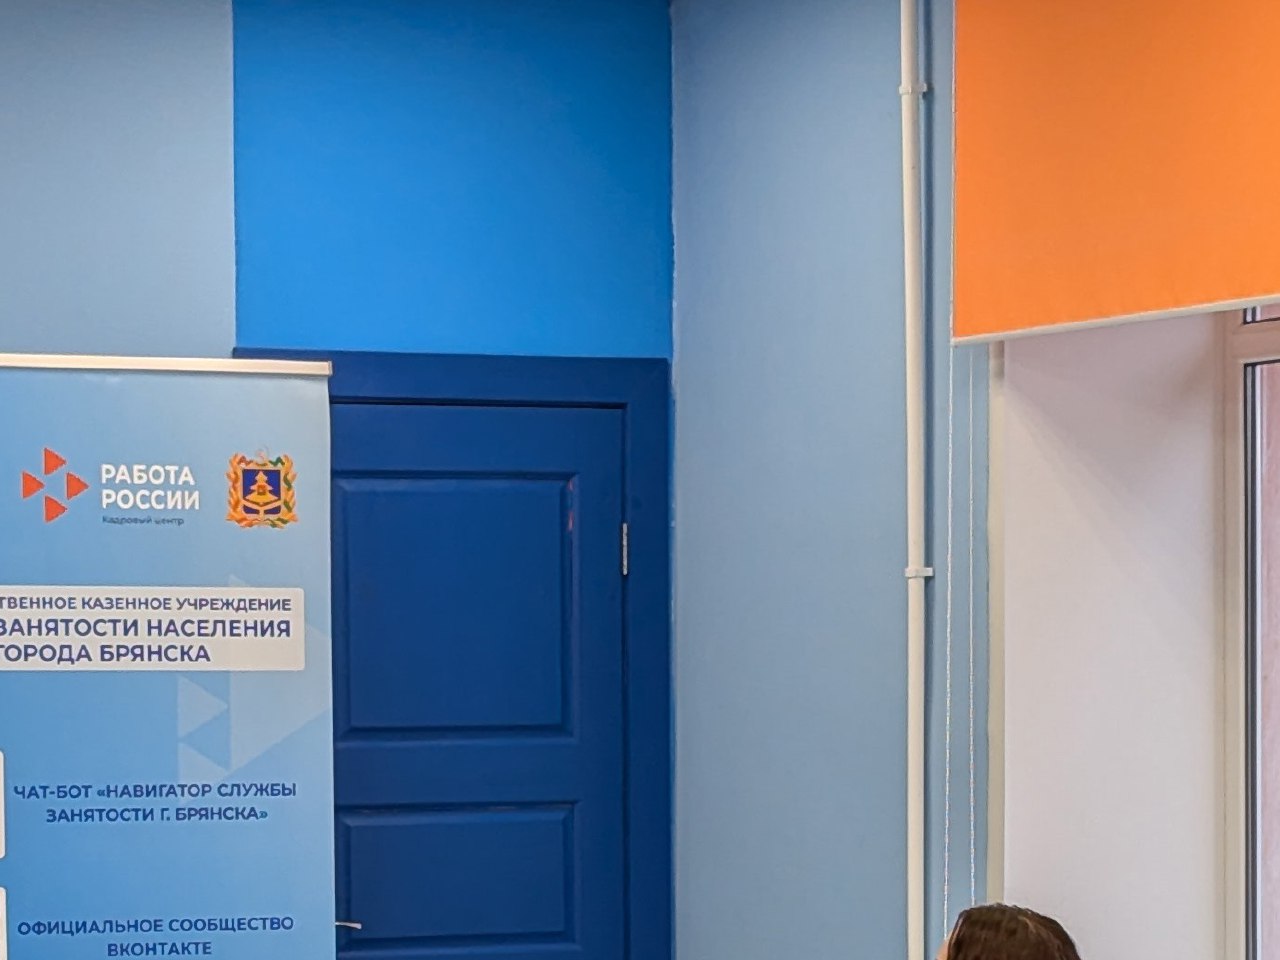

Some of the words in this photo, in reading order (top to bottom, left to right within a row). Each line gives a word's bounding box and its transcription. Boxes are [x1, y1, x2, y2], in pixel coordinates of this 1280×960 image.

[101, 463, 196, 486] РАБОТА
[101, 489, 200, 510] РОССИИ
[102, 515, 152, 525] Кадровый
[154, 518, 185, 526] центр
[81, 596, 172, 611] КАЗЕННОЕ
[176, 598, 292, 613] УЧРЕЖДЕНИЕ
[146, 619, 291, 638] НАСЕЛЕНИЯ
[100, 644, 211, 662] БРЯНСКА
[13, 784, 93, 799] ЧАТ-БОТ
[96, 783, 212, 798] «НАВИГАТОР
[218, 783, 297, 798] СЛУЖБЫ
[46, 808, 155, 823] ЗАНЯТОСТИ
[160, 808, 171, 821] Г.
[175, 806, 268, 821] БРЯНСКА»
[17, 919, 164, 936] ОФИЦИАЛЬНОЕ
[168, 916, 295, 932] СООБЩЕСТВО
[107, 941, 212, 957] ВКОНТАКТЕ
